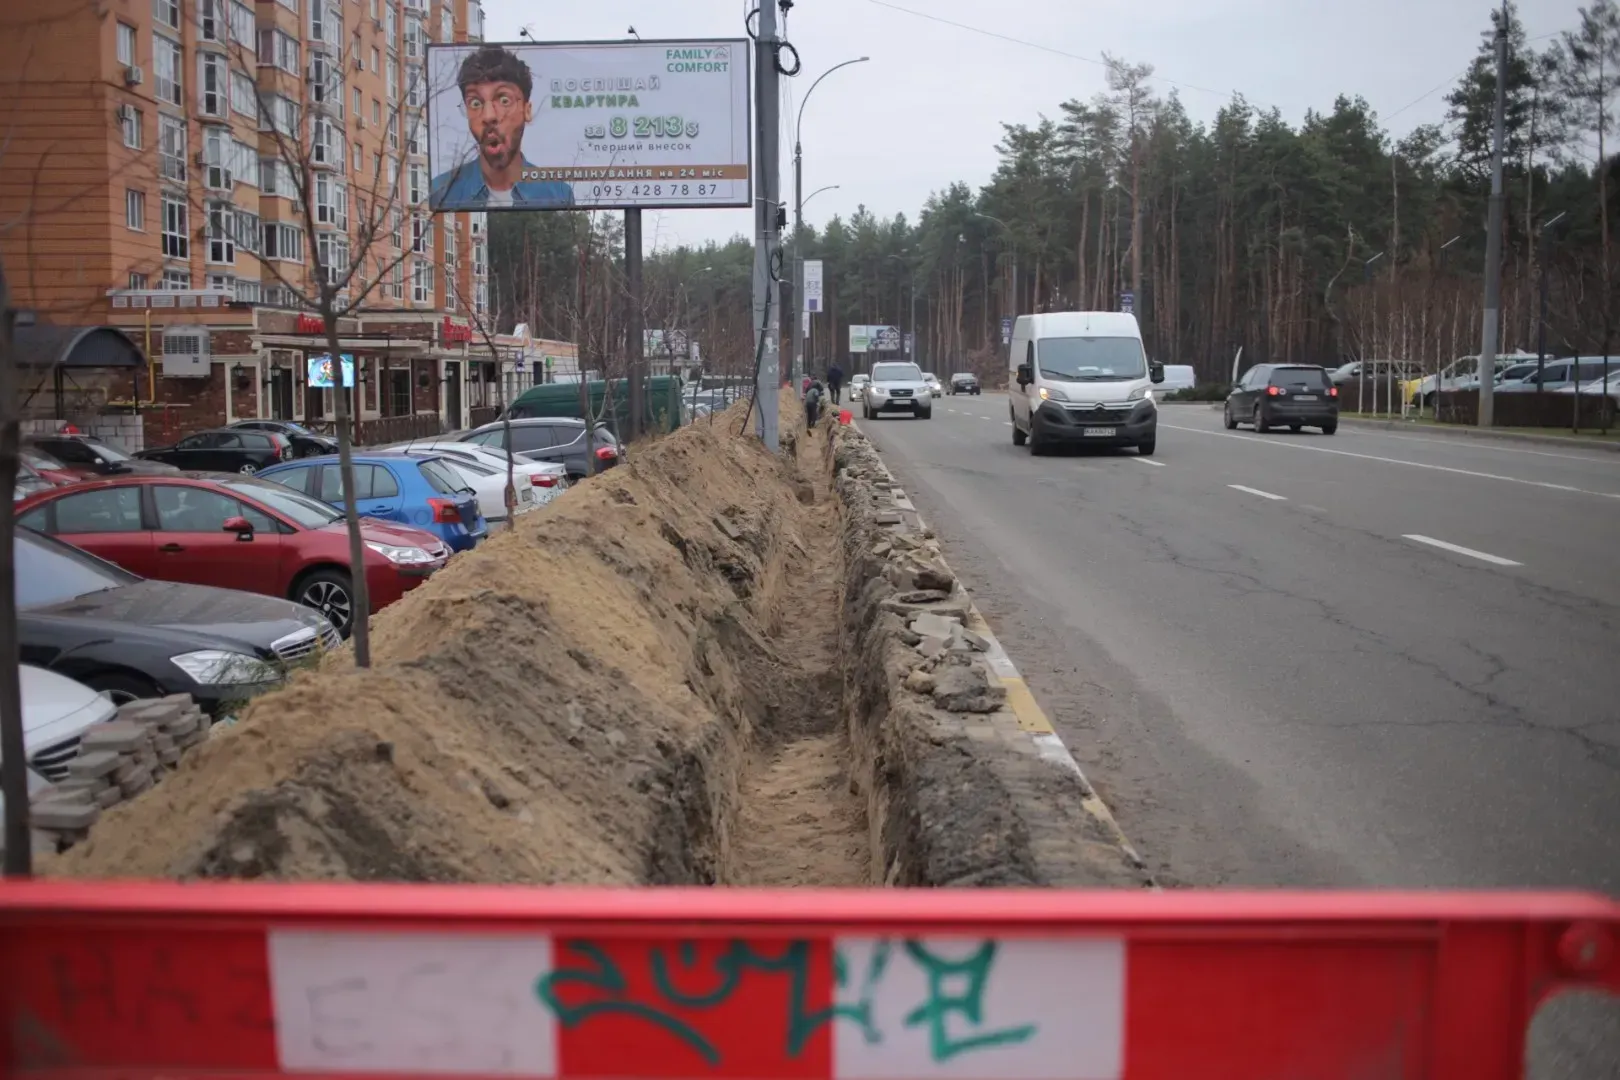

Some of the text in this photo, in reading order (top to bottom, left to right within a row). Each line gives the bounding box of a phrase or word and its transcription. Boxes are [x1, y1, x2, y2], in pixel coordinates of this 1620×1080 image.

[666, 49, 712, 60] FAMILY
[667, 62, 728, 73] COMFORT
[551, 75, 660, 92] ПОСПІШАЙ
[551, 94, 639, 109] КВАРТИРА
[584, 124, 605, 138] за
[610, 116, 627, 137] 8
[648, 142, 692, 151] внесок
[521, 168, 724, 180] РОЗТЕРМІНУВАННЯ на 24 міс
[593, 183, 717, 197] 095 428 78 87
